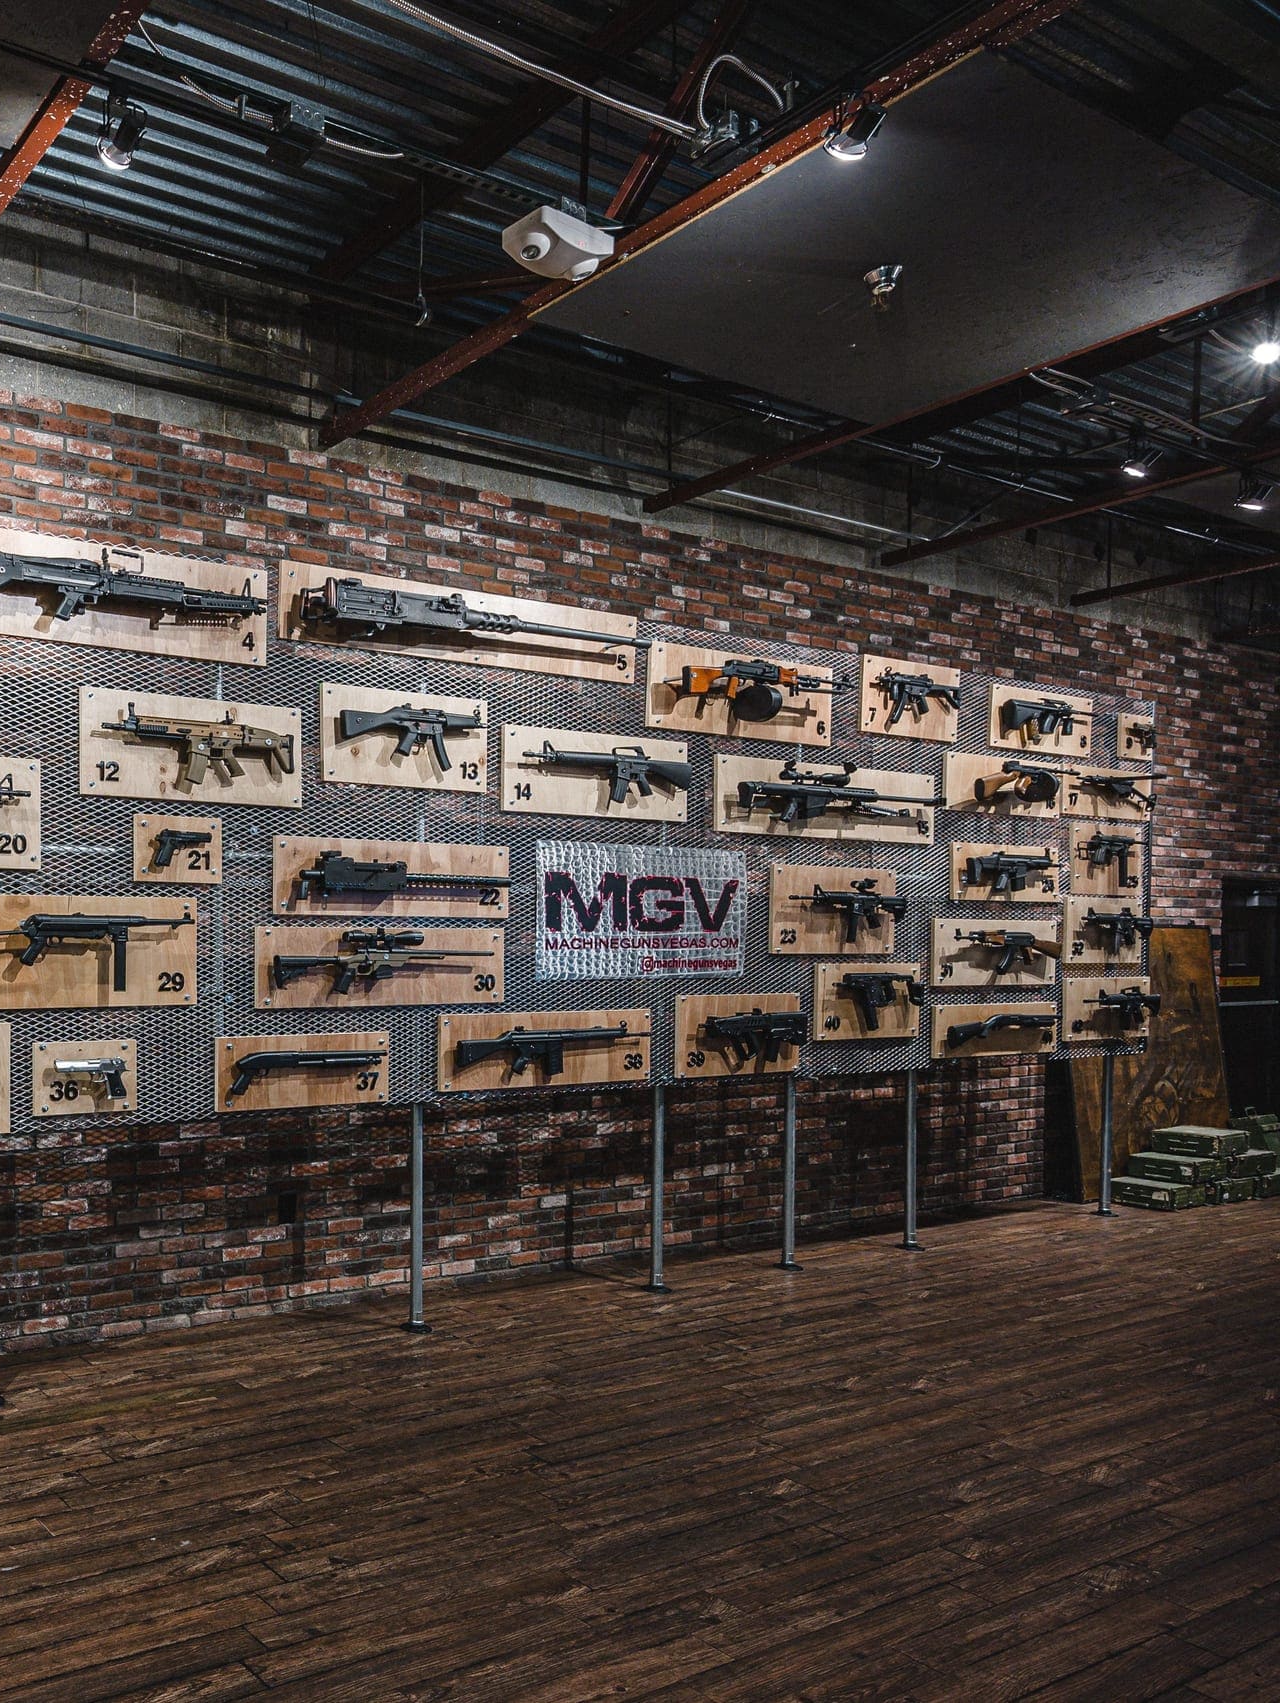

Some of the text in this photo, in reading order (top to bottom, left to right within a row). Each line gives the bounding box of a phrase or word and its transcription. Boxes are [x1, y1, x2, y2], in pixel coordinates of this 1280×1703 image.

[242, 632, 255, 651] 4
[617, 654, 627, 671] 5
[869, 707, 877, 722] 7
[817, 721, 826, 735] 6
[96, 760, 120, 782] 12
[459, 761, 479, 780] 13
[514, 783, 532, 800] 14
[1069, 793, 1078, 806] 17
[188, 850, 210, 870] 21
[478, 888, 501, 906] 22
[544, 871, 740, 933] MGV
[545, 937, 739, 951] MACHINEGUNSVEGAS.COM
[780, 928, 797, 945] 23
[642, 956, 737, 972] @machinegunsvegas
[157, 971, 185, 994] 29
[473, 973, 496, 993] 30
[824, 1016, 840, 1032] 40
[624, 1052, 643, 1070] 38
[687, 1051, 705, 1068] 39
[356, 1071, 379, 1091] 37
[49, 1080, 79, 1102] 36
